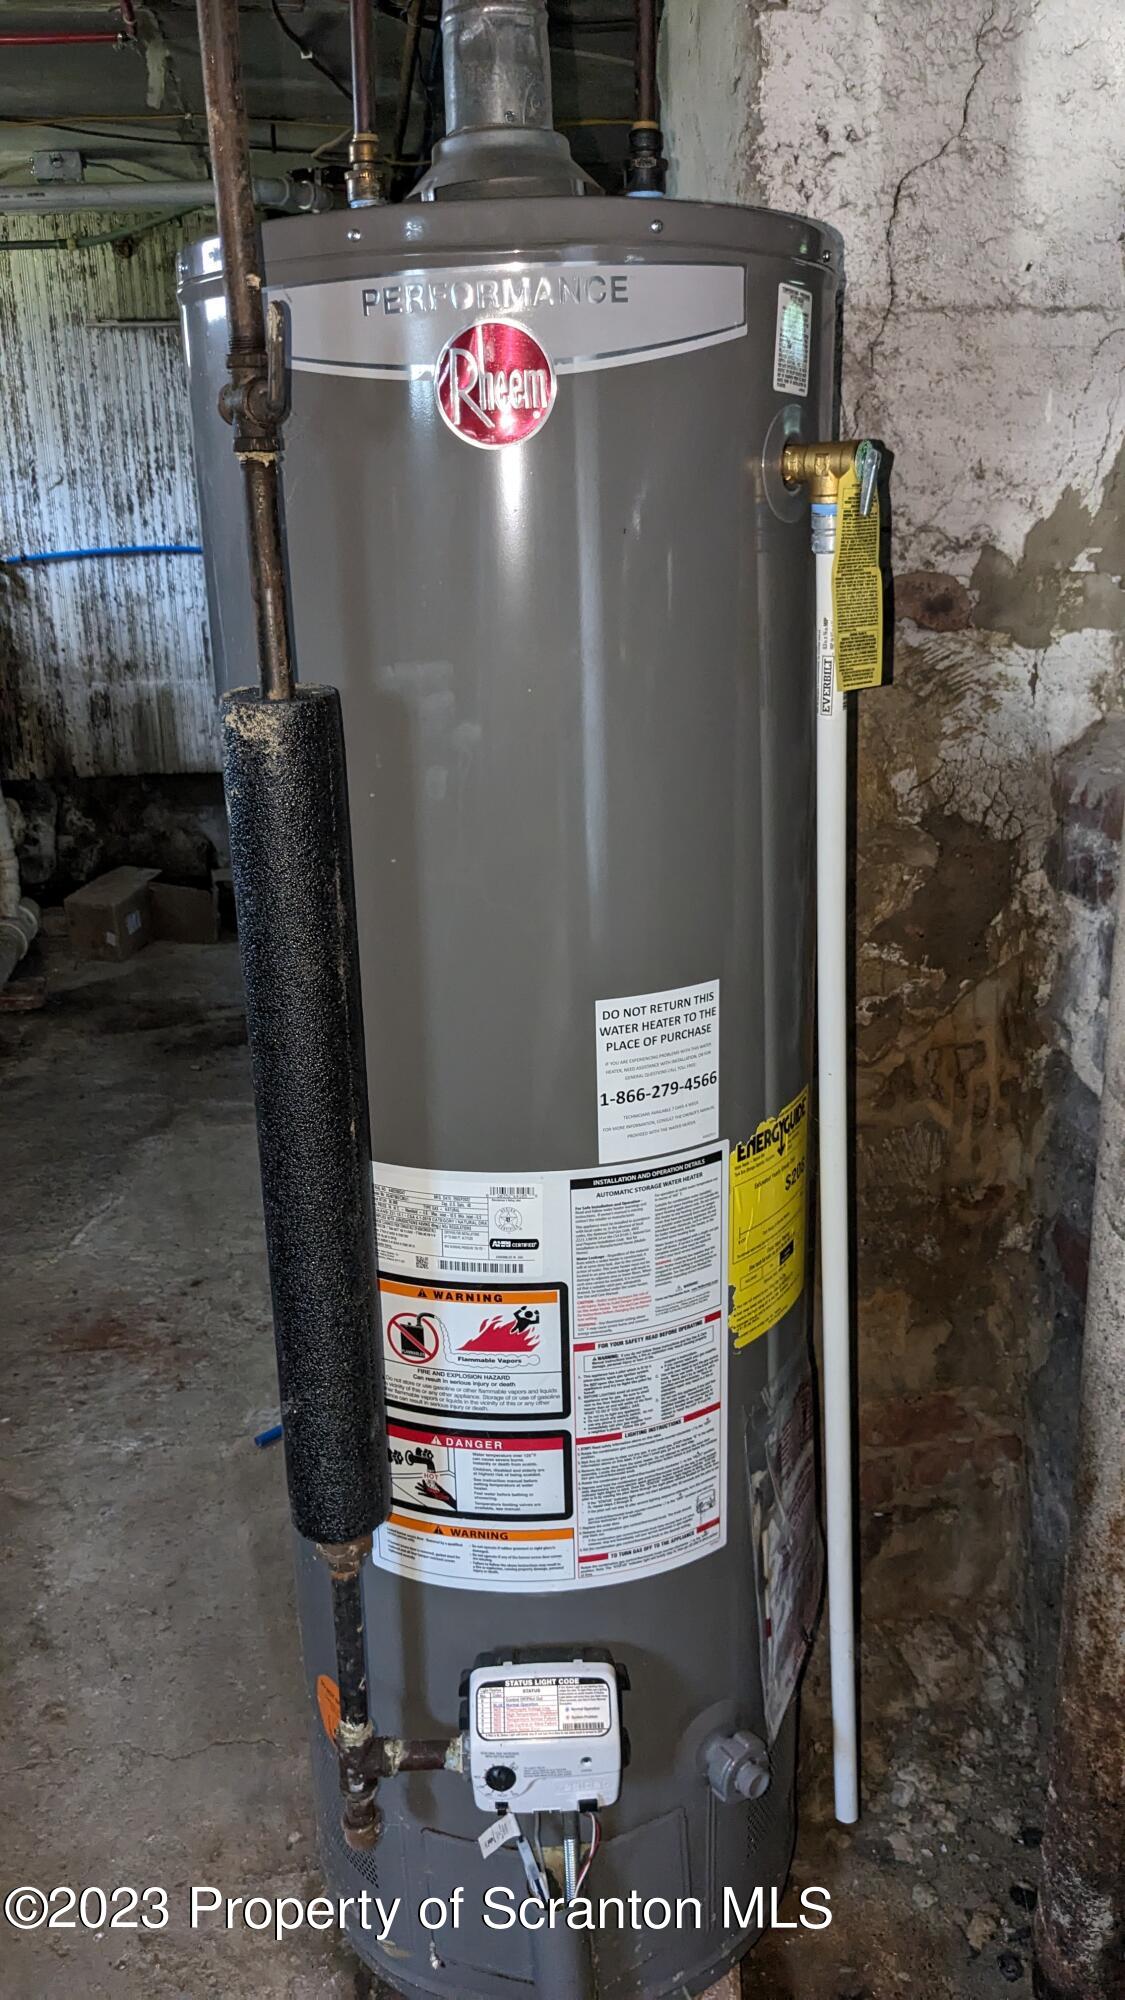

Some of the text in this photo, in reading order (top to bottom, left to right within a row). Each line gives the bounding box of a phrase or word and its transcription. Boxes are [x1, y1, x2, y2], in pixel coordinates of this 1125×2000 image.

[361, 274, 630, 318] PERFORMANCE
[449, 323, 549, 428] Rheem
[822, 658, 833, 713] EVERBILT
[603, 991, 715, 1020] DO NOT RETURN THIS
[600, 1006, 717, 1036] WATER HEATER TO THE
[606, 1023, 712, 1052] PLACE OF PURCHASE
[600, 1070, 718, 1107] 1-866-279-4566
[593, 1158, 706, 1186] INSTALLATION AND OPERATION DETAILS
[596, 1171, 703, 1199] AUTOMATIC STORAGE WATER HEATER
[433, 1290, 503, 1303] WARNING
[598, 1320, 703, 1349] FOR YOUR SAFETY READ BEFORE OPERATING
[457, 1356, 522, 1365] Flammable Vapors
[446, 1372, 482, 1380] EXPLOSION
[624, 1419, 682, 1438] LIGHTING INSTRUCTIONS
[445, 1437, 503, 1449] DANGER
[424, 1472, 438, 1480] HOT
[450, 1528, 509, 1540] WARNING
[670, 1530, 695, 1544] APPLIANCE
[504, 1677, 580, 1687] STATUS LIGHT CODE
